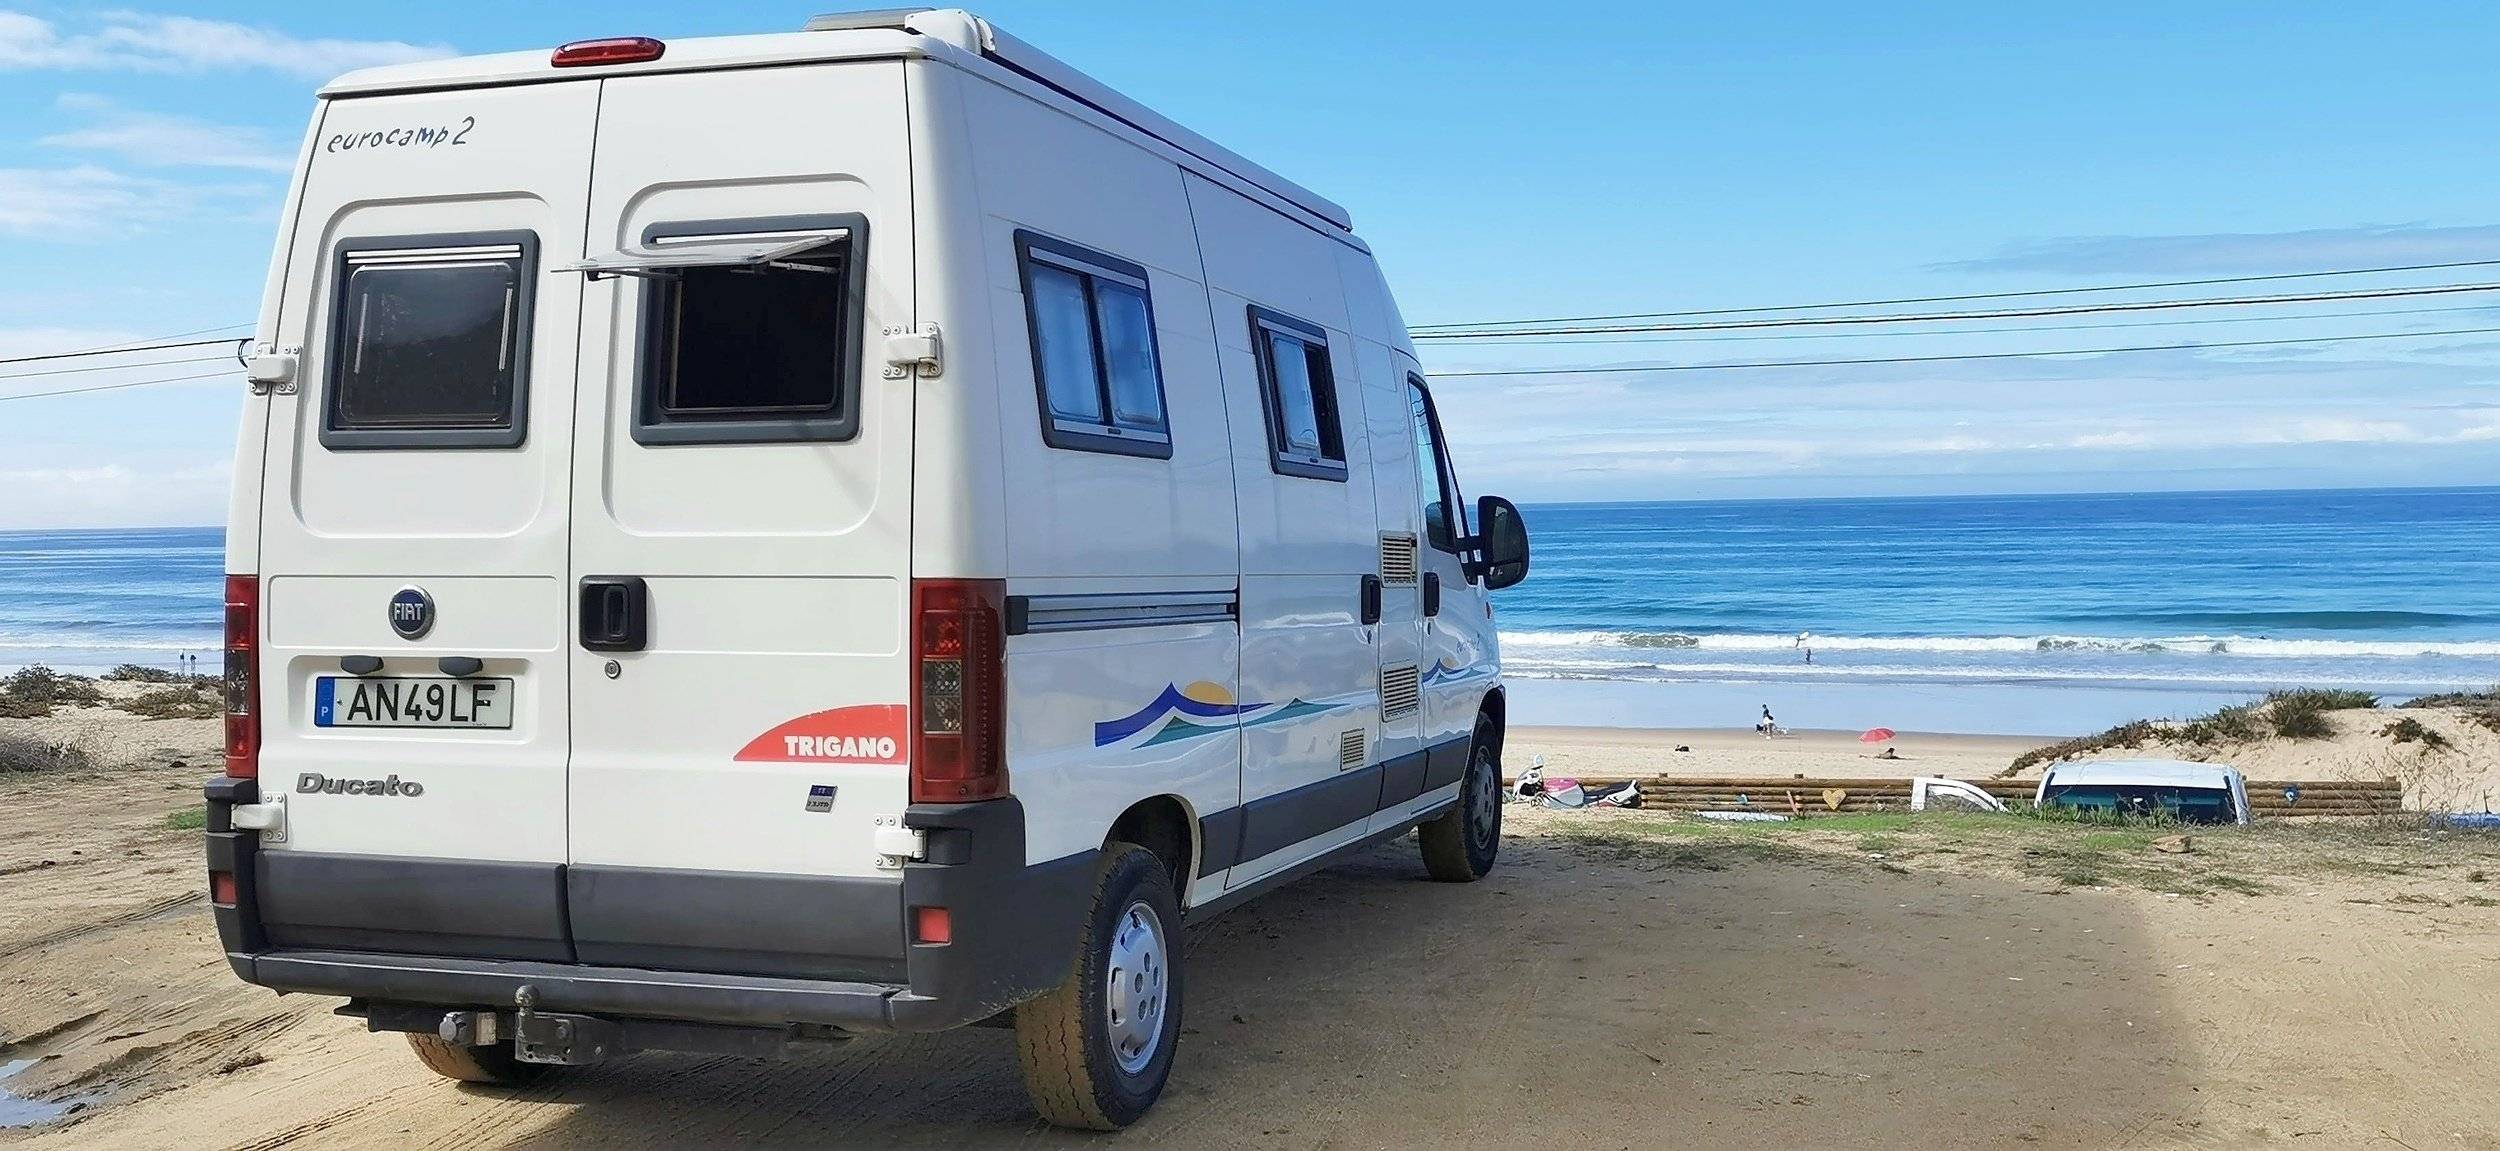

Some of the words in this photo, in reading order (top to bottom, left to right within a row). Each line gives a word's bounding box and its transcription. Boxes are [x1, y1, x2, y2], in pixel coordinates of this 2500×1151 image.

[327, 126, 449, 153] eurocamp
[452, 115, 475, 146] 2
[393, 602, 424, 621] FIAT
[321, 706, 329, 717] P
[347, 683, 496, 722] AN49LF
[784, 736, 897, 759] TRIGANO
[296, 772, 424, 797] Ducato
